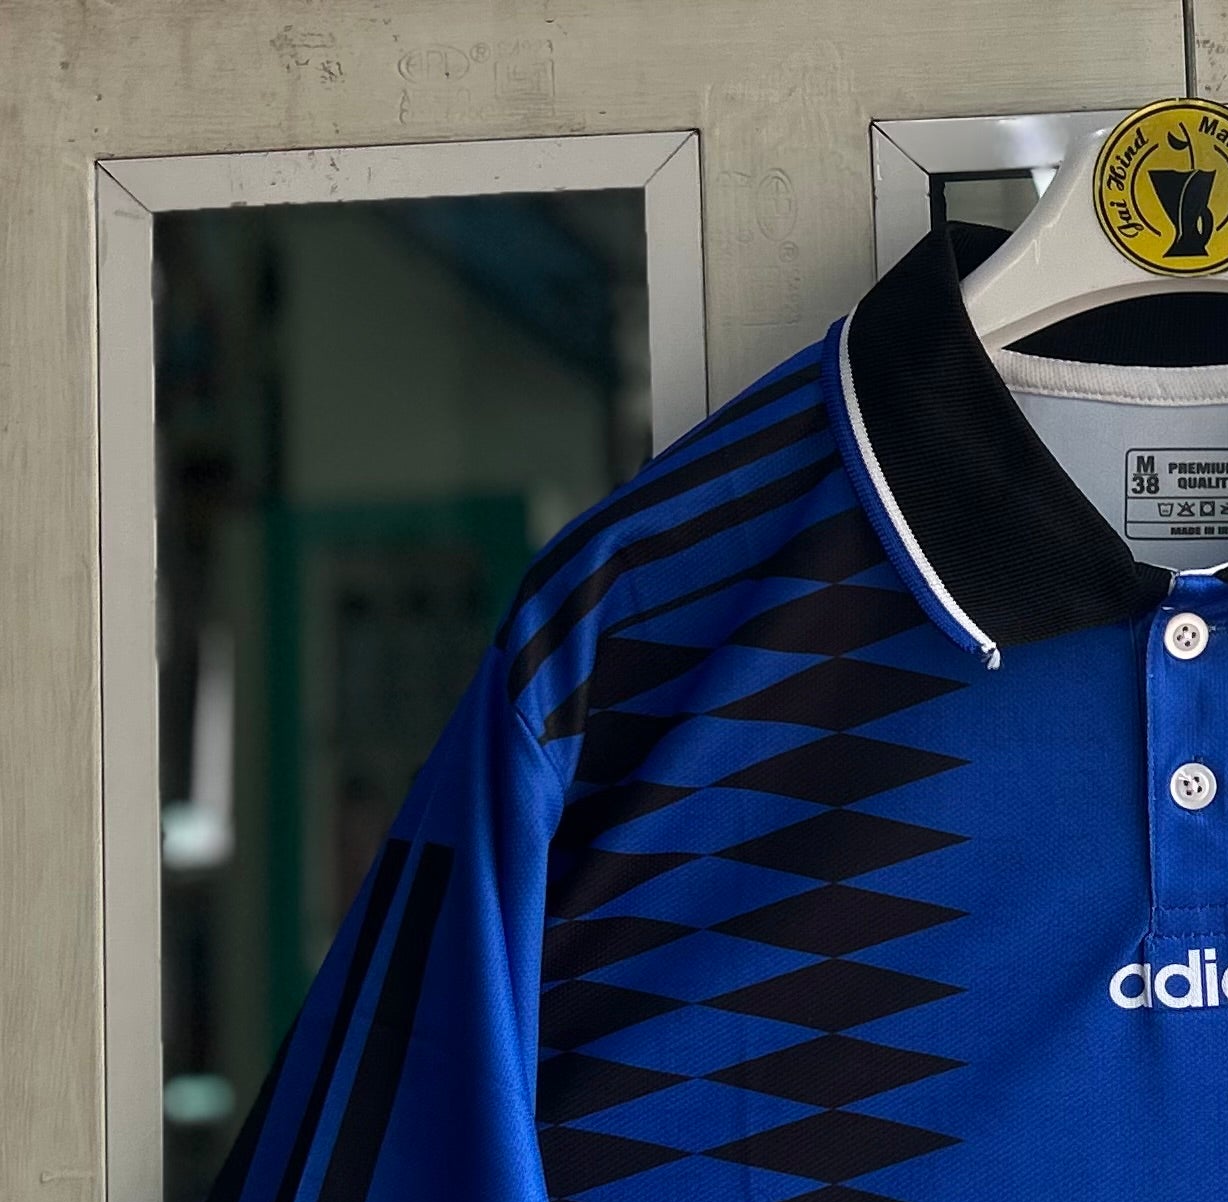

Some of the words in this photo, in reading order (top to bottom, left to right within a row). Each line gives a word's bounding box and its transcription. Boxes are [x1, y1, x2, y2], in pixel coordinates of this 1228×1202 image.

[1107, 127, 1149, 191] Hind
[1110, 200, 1144, 238] Jai
[1136, 455, 1155, 473] M
[1131, 476, 1160, 495] 38
[1170, 527, 1201, 535] MADE
[1204, 526, 1215, 535] IN
